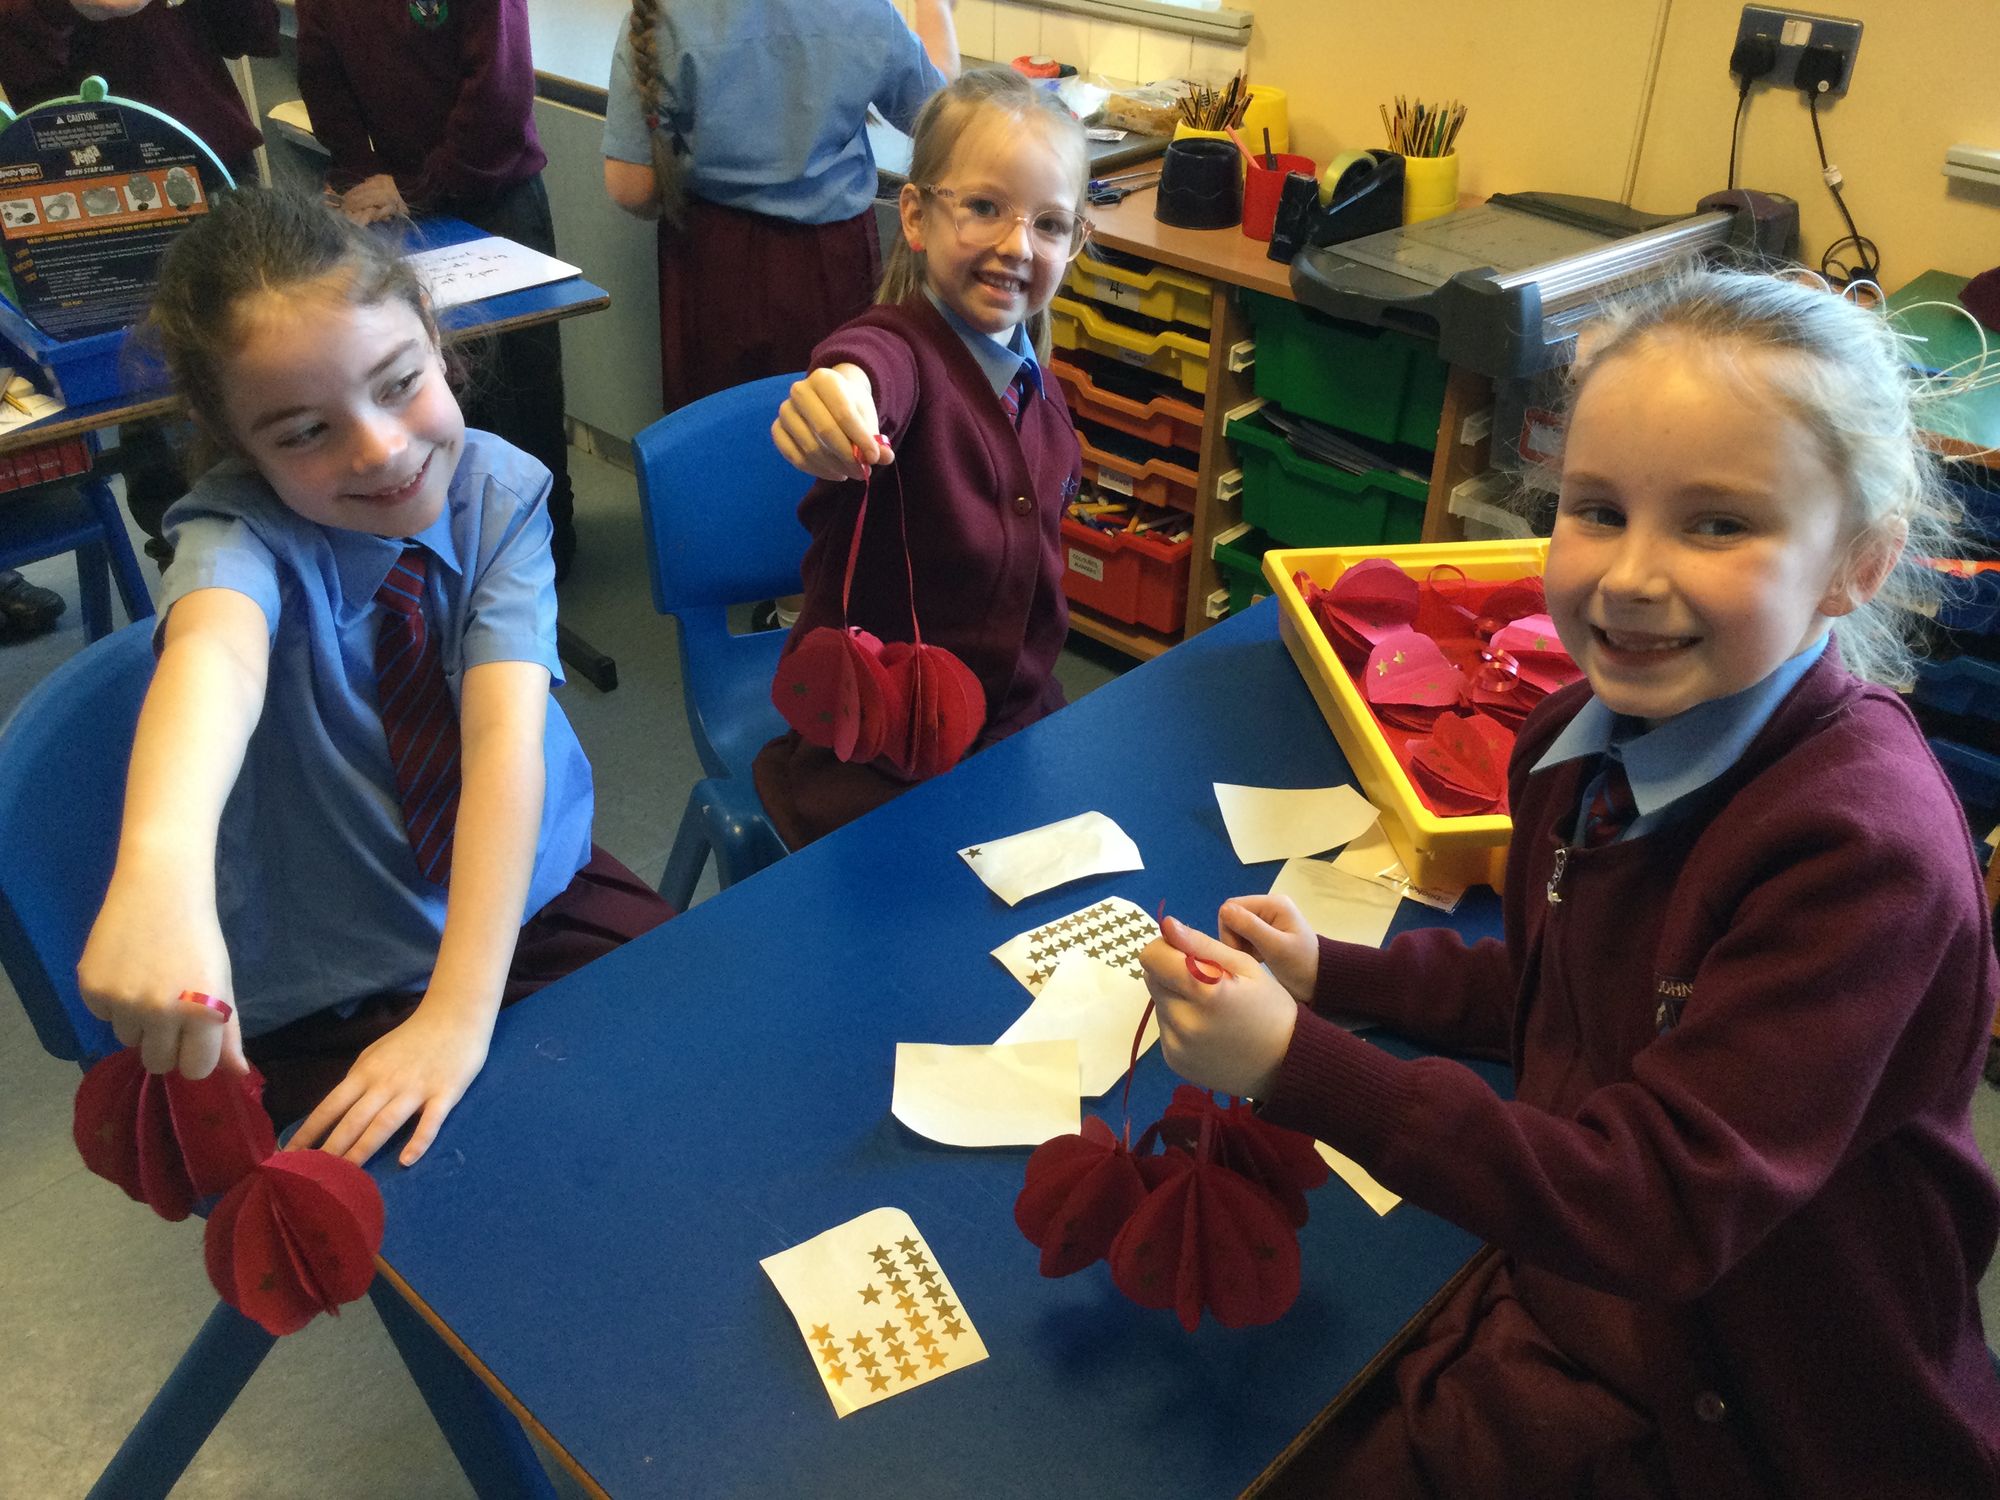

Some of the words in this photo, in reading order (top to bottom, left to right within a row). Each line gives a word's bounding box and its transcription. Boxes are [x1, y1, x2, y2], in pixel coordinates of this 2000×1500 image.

[70, 145, 102, 166] Jenga
[65, 168, 83, 176] DEATH
[84, 166, 98, 174] STAR
[1110, 281, 1123, 300] 4
